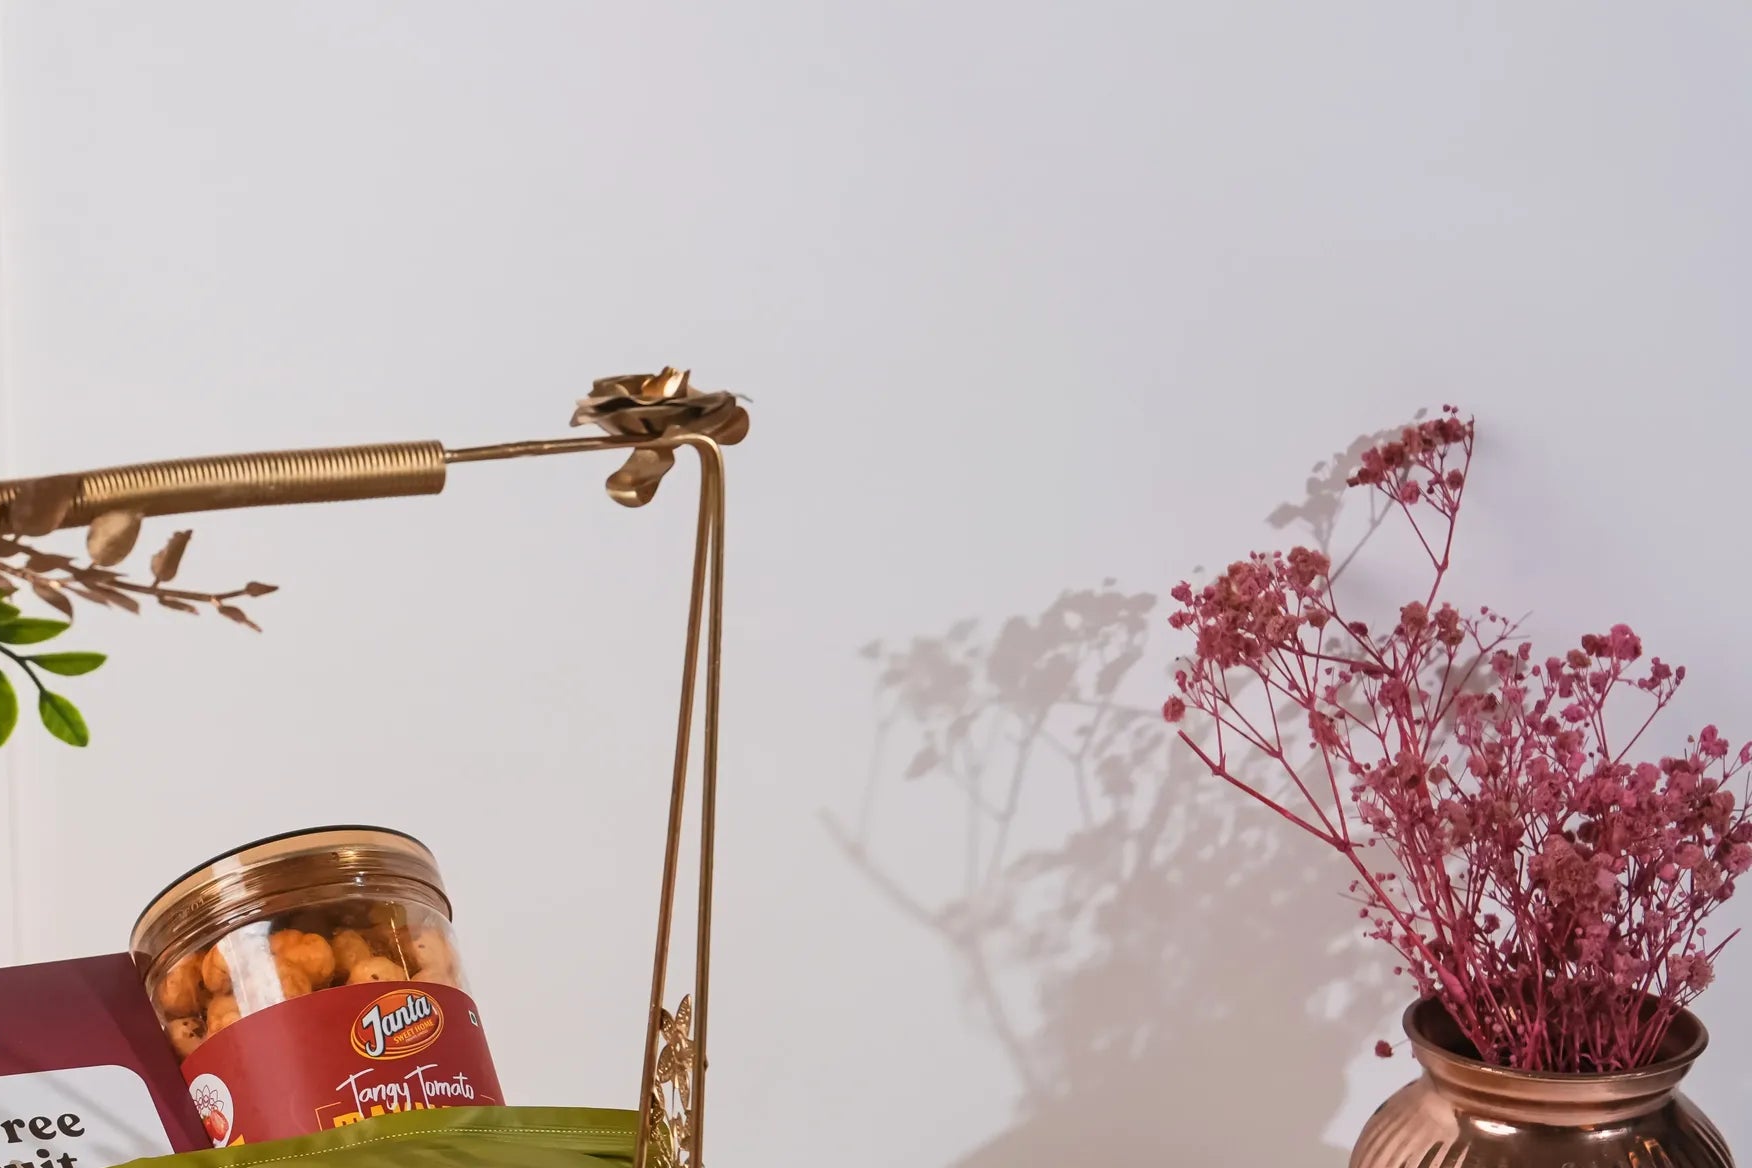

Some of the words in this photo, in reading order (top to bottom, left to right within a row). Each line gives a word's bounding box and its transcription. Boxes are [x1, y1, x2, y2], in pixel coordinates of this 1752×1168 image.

[362, 994, 432, 1057] Janta
[393, 1027, 415, 1045] SWEET
[415, 1018, 435, 1035] HOME
[335, 1067, 413, 1119] Tangy
[404, 1063, 475, 1109] Tomato
